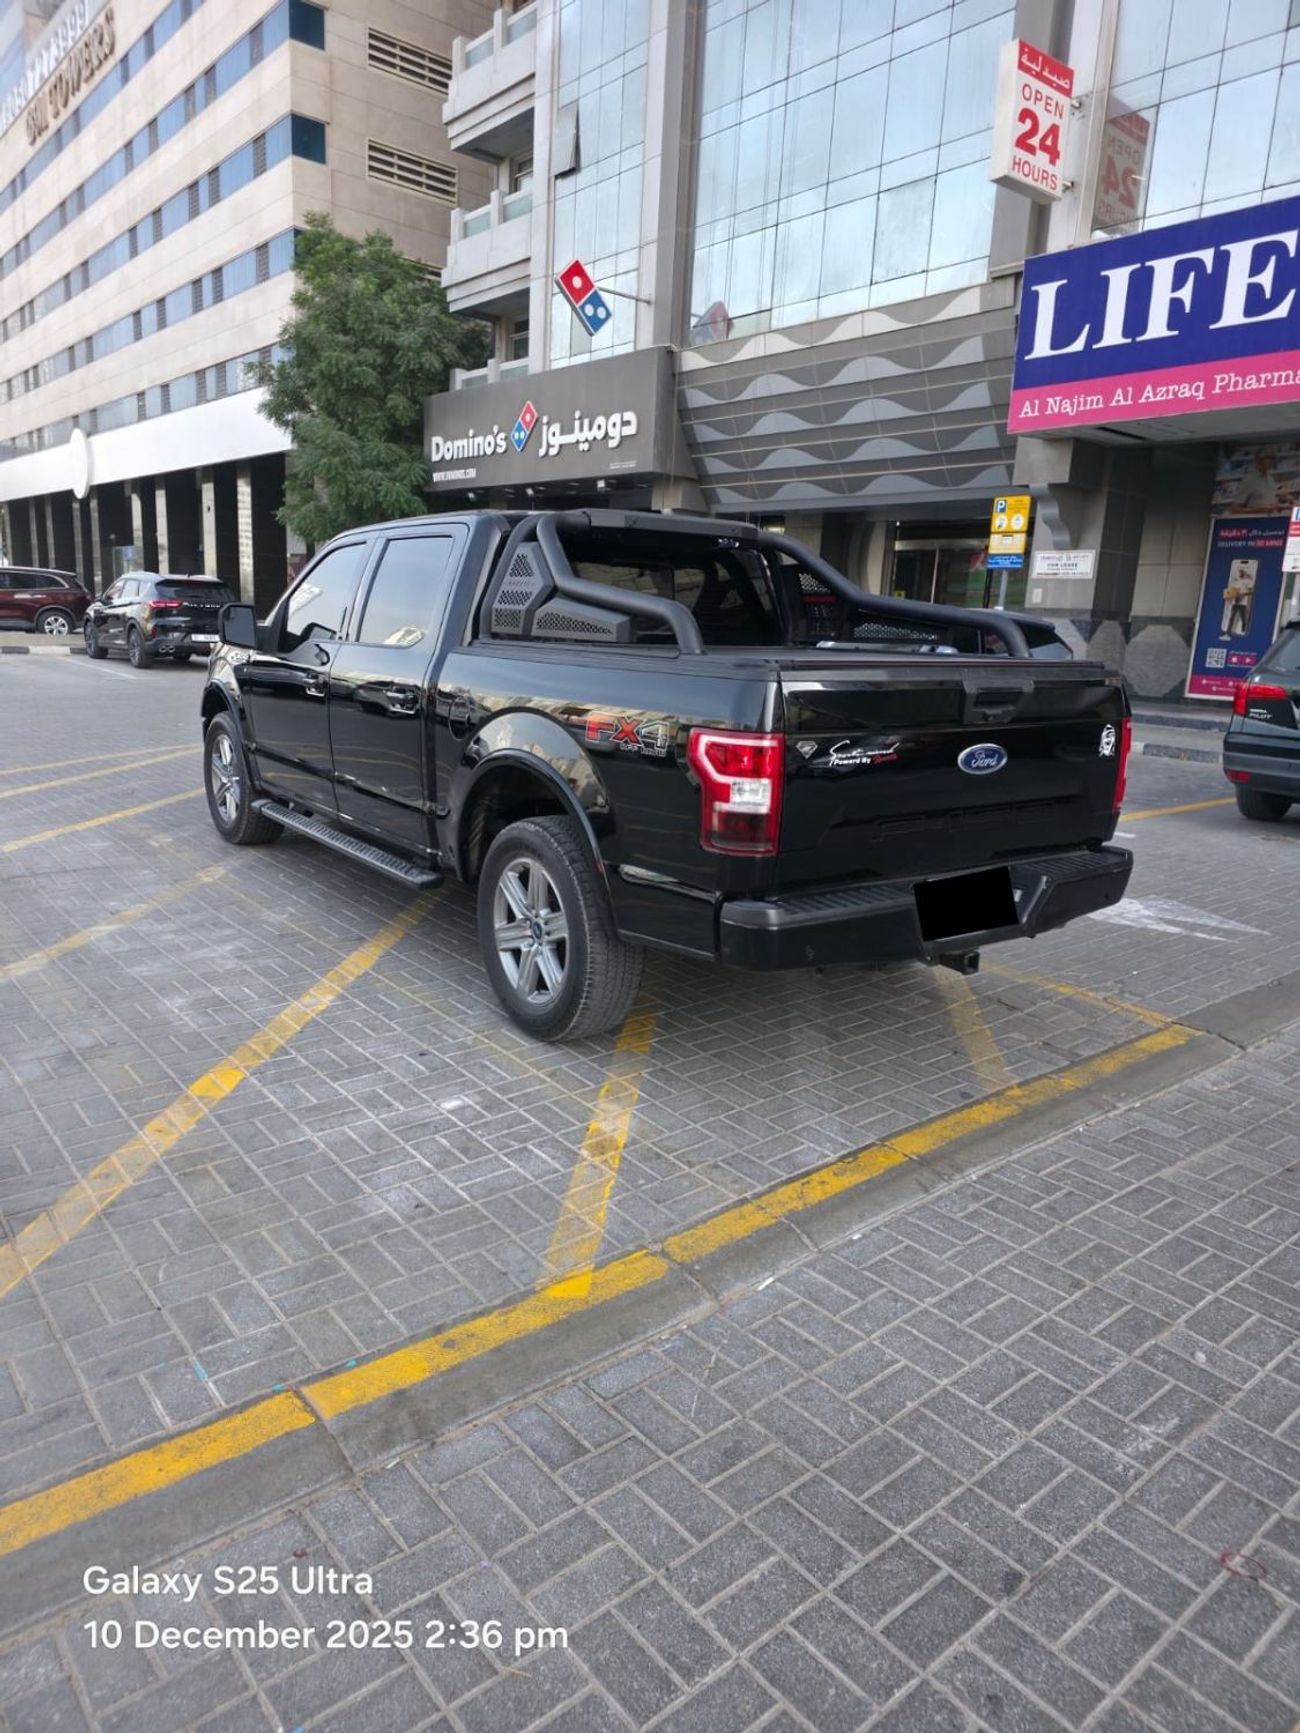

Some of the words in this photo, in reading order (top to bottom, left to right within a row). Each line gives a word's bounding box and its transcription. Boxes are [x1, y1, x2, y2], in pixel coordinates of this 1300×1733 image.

[1020, 48, 1071, 89] صيدلية
[1021, 83, 1065, 121] OPEN
[1014, 107, 1061, 167] 24
[1011, 155, 1058, 191] HOURS
[1023, 229, 1299, 361] LIFE
[1018, 400, 1040, 418] Al
[1045, 394, 1104, 416] Najim
[1109, 386, 1134, 407] Al
[1138, 378, 1206, 403] Azraq
[431, 425, 507, 462] Domino's
[538, 410, 638, 457] دومينوز
[997, 500, 1006, 513] P
[585, 711, 670, 750] FX4
[971, 750, 999, 768] Ford
